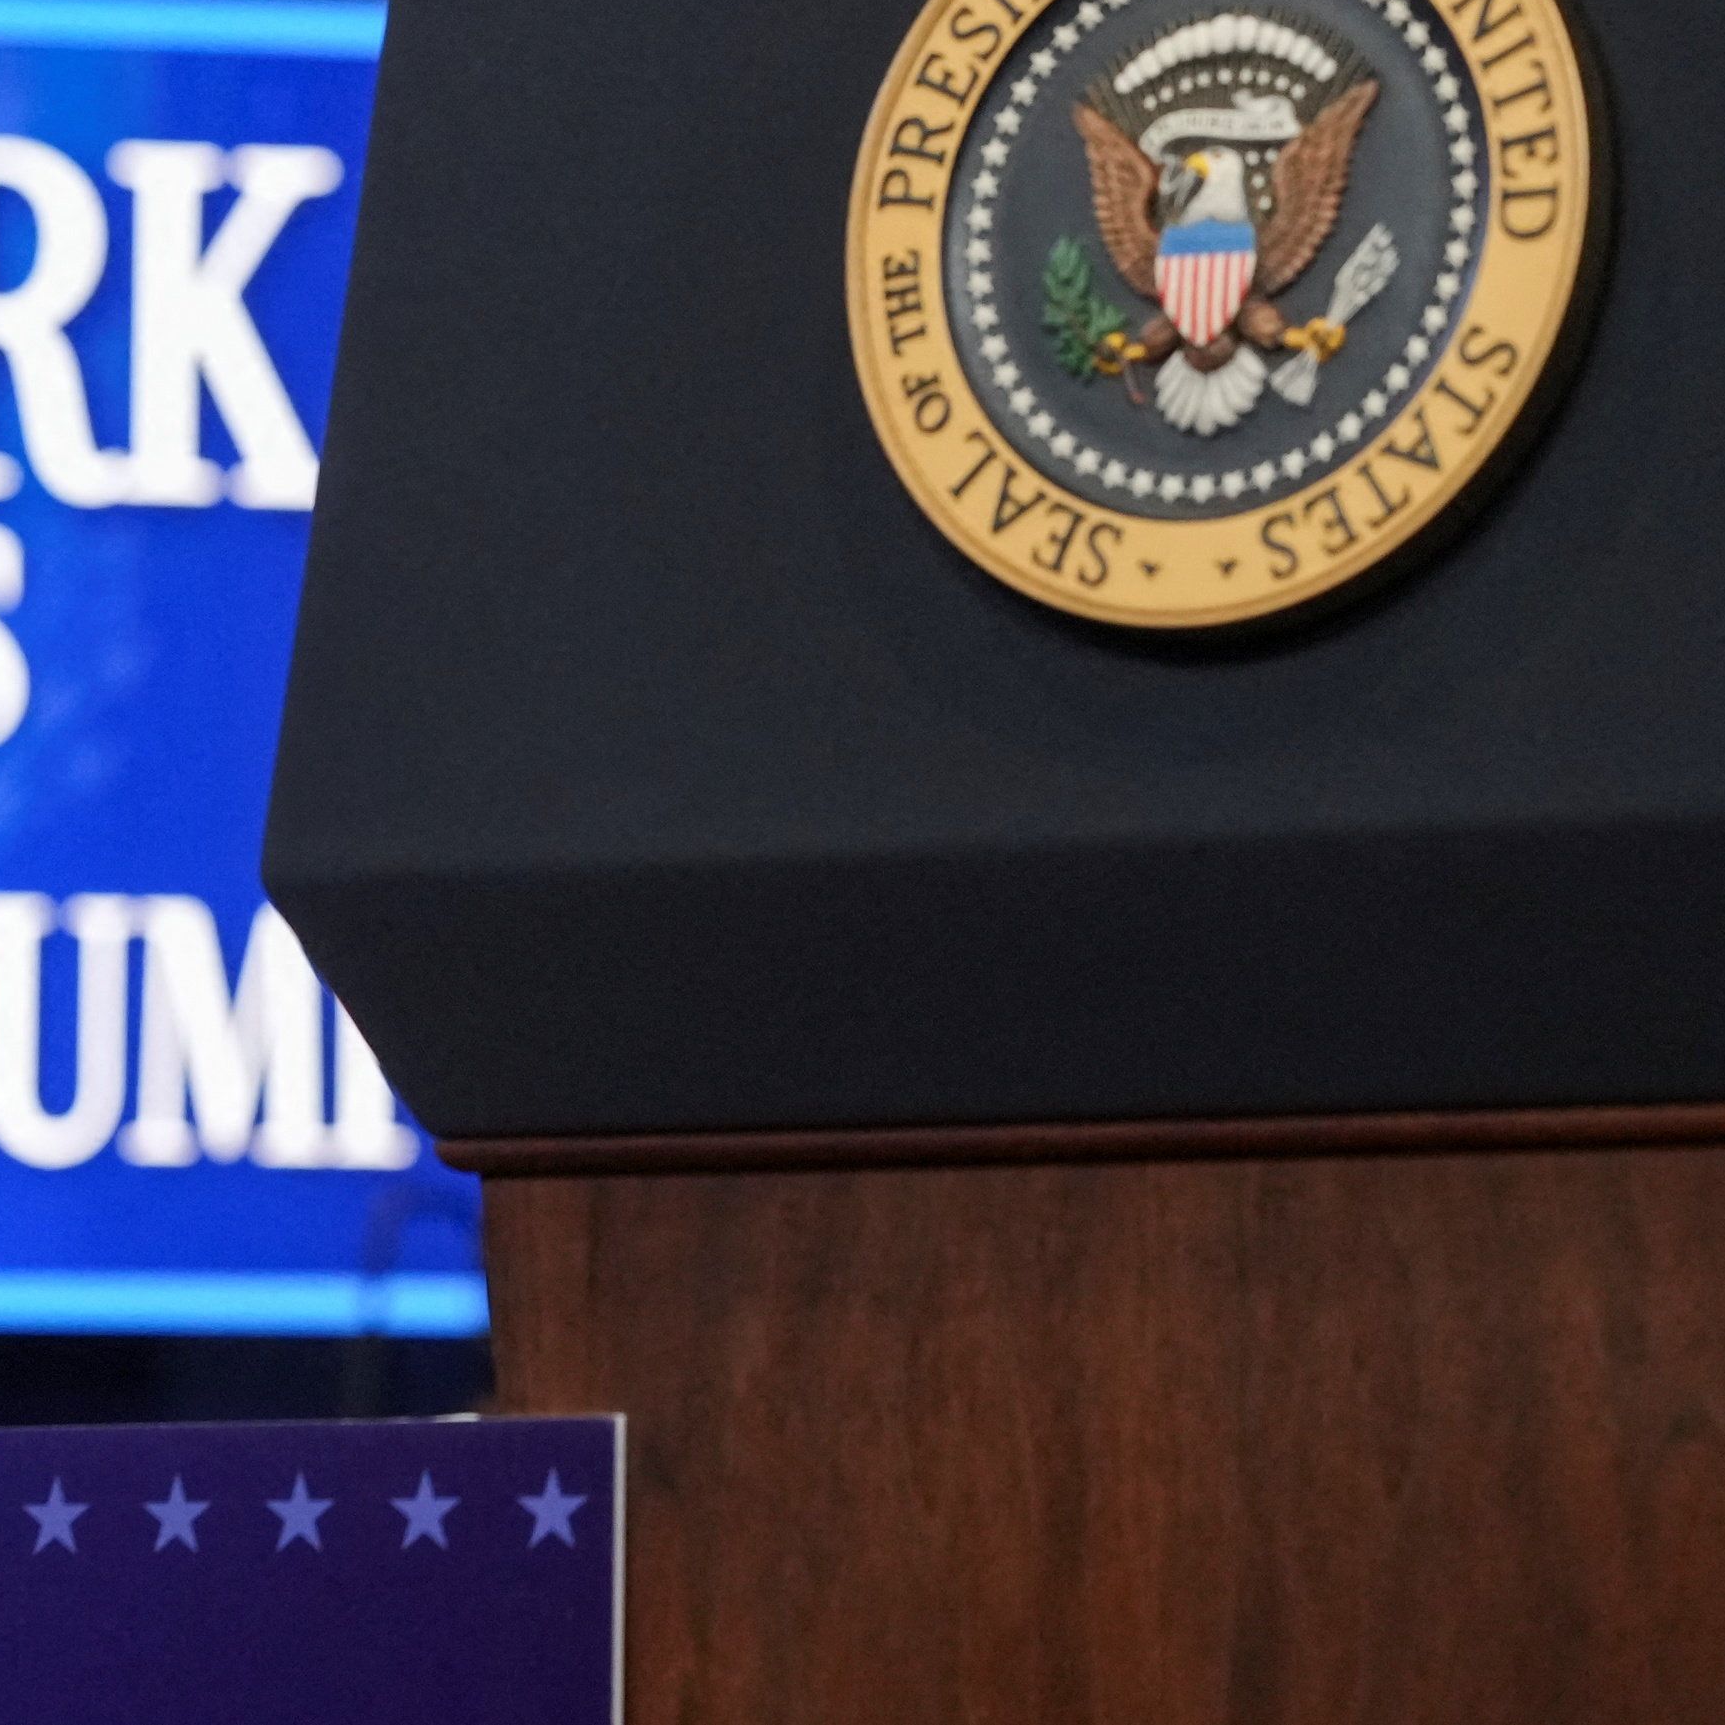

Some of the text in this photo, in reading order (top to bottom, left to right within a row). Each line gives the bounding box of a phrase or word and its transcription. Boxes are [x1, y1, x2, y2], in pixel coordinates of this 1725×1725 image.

[880, 248, 927, 356] THE
[902, 374, 951, 434] OF
[1259, 324, 1519, 582] STATES
[951, 430, 1124, 588] SEAL
